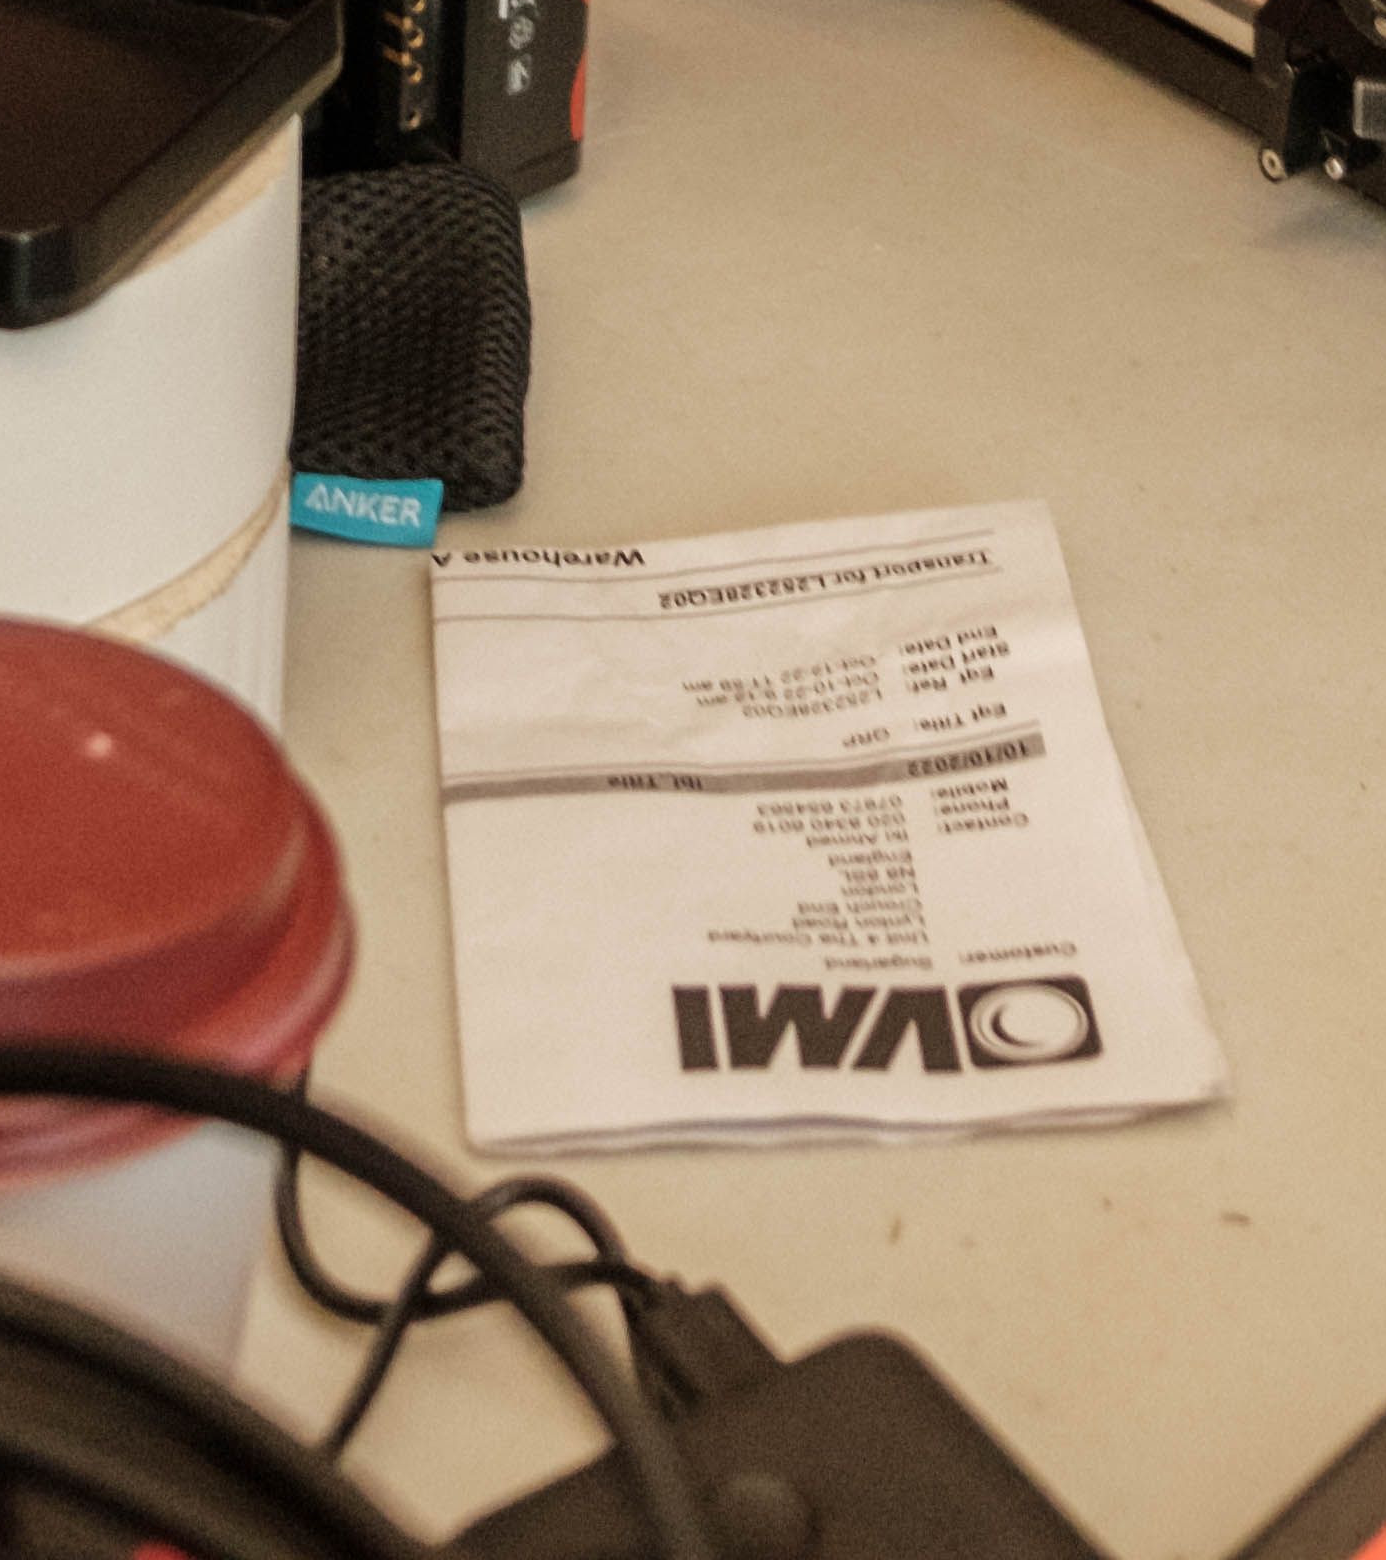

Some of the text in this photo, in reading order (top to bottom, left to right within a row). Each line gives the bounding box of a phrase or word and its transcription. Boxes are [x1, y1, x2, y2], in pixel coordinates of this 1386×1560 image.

[305, 483, 422, 528] ANKER
[461, 548, 645, 569] Warehouse
[871, 550, 989, 580] Transport
[832, 568, 868, 586] for
[956, 623, 999, 644] End
[900, 636, 952, 657] Date:
[961, 640, 1011, 663] Start
[902, 656, 955, 677] Date:
[681, 679, 714, 694] am
[905, 676, 948, 695] Ref:
[695, 694, 728, 708] am
[914, 714, 963, 733] Title:
[906, 741, 1030, 776] 10/10/2022
[929, 777, 1009, 801] Mobile:
[932, 797, 1011, 818] Phone:
[936, 812, 1030, 835] Contact:
[805, 831, 880, 849] Ahmed
[827, 849, 913, 868] England
[841, 882, 920, 899] London
[796, 899, 923, 917] Crouch End
[791, 917, 849, 931] Road
[707, 928, 813, 947] Courtyard
[673, 982, 960, 1075] VMI
